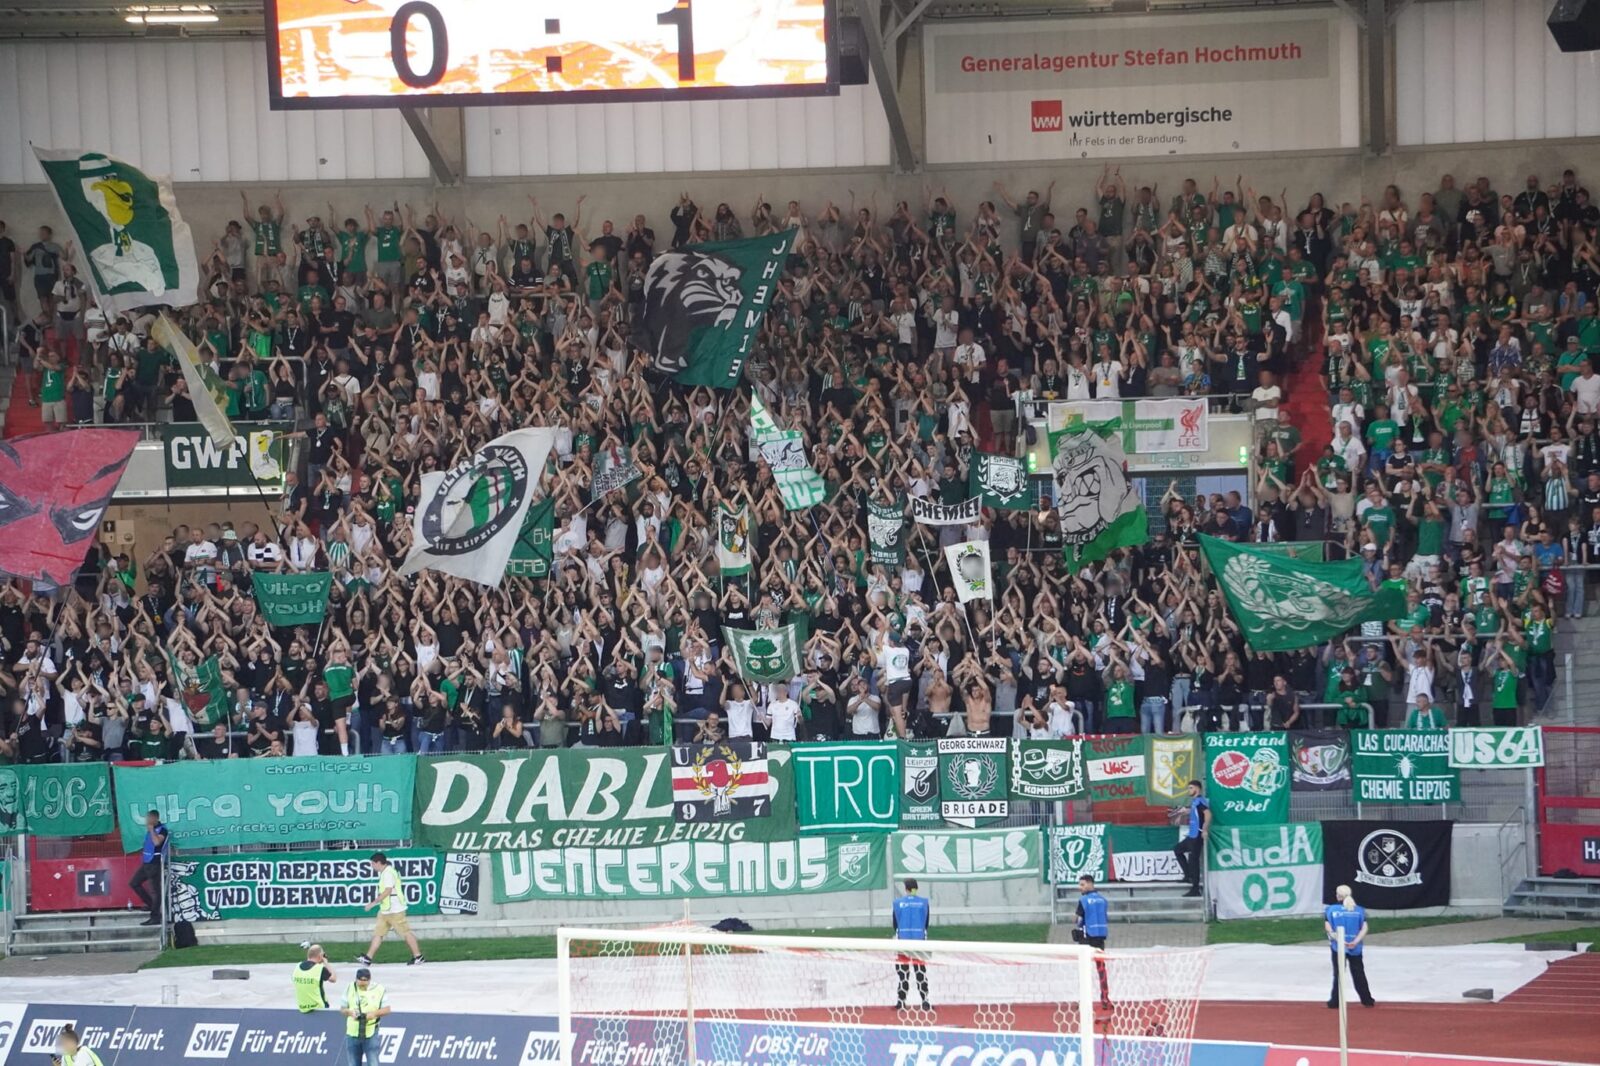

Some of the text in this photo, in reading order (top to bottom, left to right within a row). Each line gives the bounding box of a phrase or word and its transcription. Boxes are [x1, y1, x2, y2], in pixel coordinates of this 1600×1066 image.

[390, 0, 449, 88] 0
[657, 0, 695, 81] 1
[960, 43, 1302, 74] Generalagentur Stefan Hochmuth
[1069, 106, 1233, 128] württembergische
[1069, 133, 1187, 147] Ihr Fels in der Brandung.
[170, 435, 247, 469] GWP
[1178, 437, 1201, 447] LFC
[912, 498, 981, 521] CHEMIE!
[455, 524, 498, 549] LEIPZIG
[533, 528, 551, 545] 64
[939, 738, 1006, 751] GEORG SCHWARZ
[1358, 733, 1449, 752] LAS CUCARACHAS
[24, 776, 113, 818] 1964
[421, 749, 792, 826] DIABLS
[796, 754, 895, 820] TRC
[1024, 785, 1071, 796] KOMBINAT
[1361, 780, 1450, 800] CHEMIE LEIPZIG
[943, 802, 1006, 815] BRIGADE
[1223, 799, 1271, 813] Pöbel
[452, 822, 746, 850] ULTRAS CHEMIE LEIPZIG
[456, 854, 479, 863] BSG
[901, 832, 1029, 873] SKINS
[206, 858, 435, 882] GEGEN REPRESSNEN
[1117, 855, 1185, 877] WURZE
[207, 885, 250, 907] UND
[256, 882, 421, 907] ÜBERWACHG
[1242, 869, 1297, 912] 03
[442, 899, 478, 911] LEIPZIG
[80, 1026, 110, 1049] Für
[110, 1027, 165, 1051] Erfurt.
[192, 1029, 328, 1055] SWE Für Erfurt.
[408, 1035, 440, 1059] Für
[440, 1035, 498, 1060] Erfurt.
[745, 1033, 829, 1056] JOBS FÜR
[580, 1040, 613, 1064] Für
[613, 1041, 673, 1066] Erfurt.
